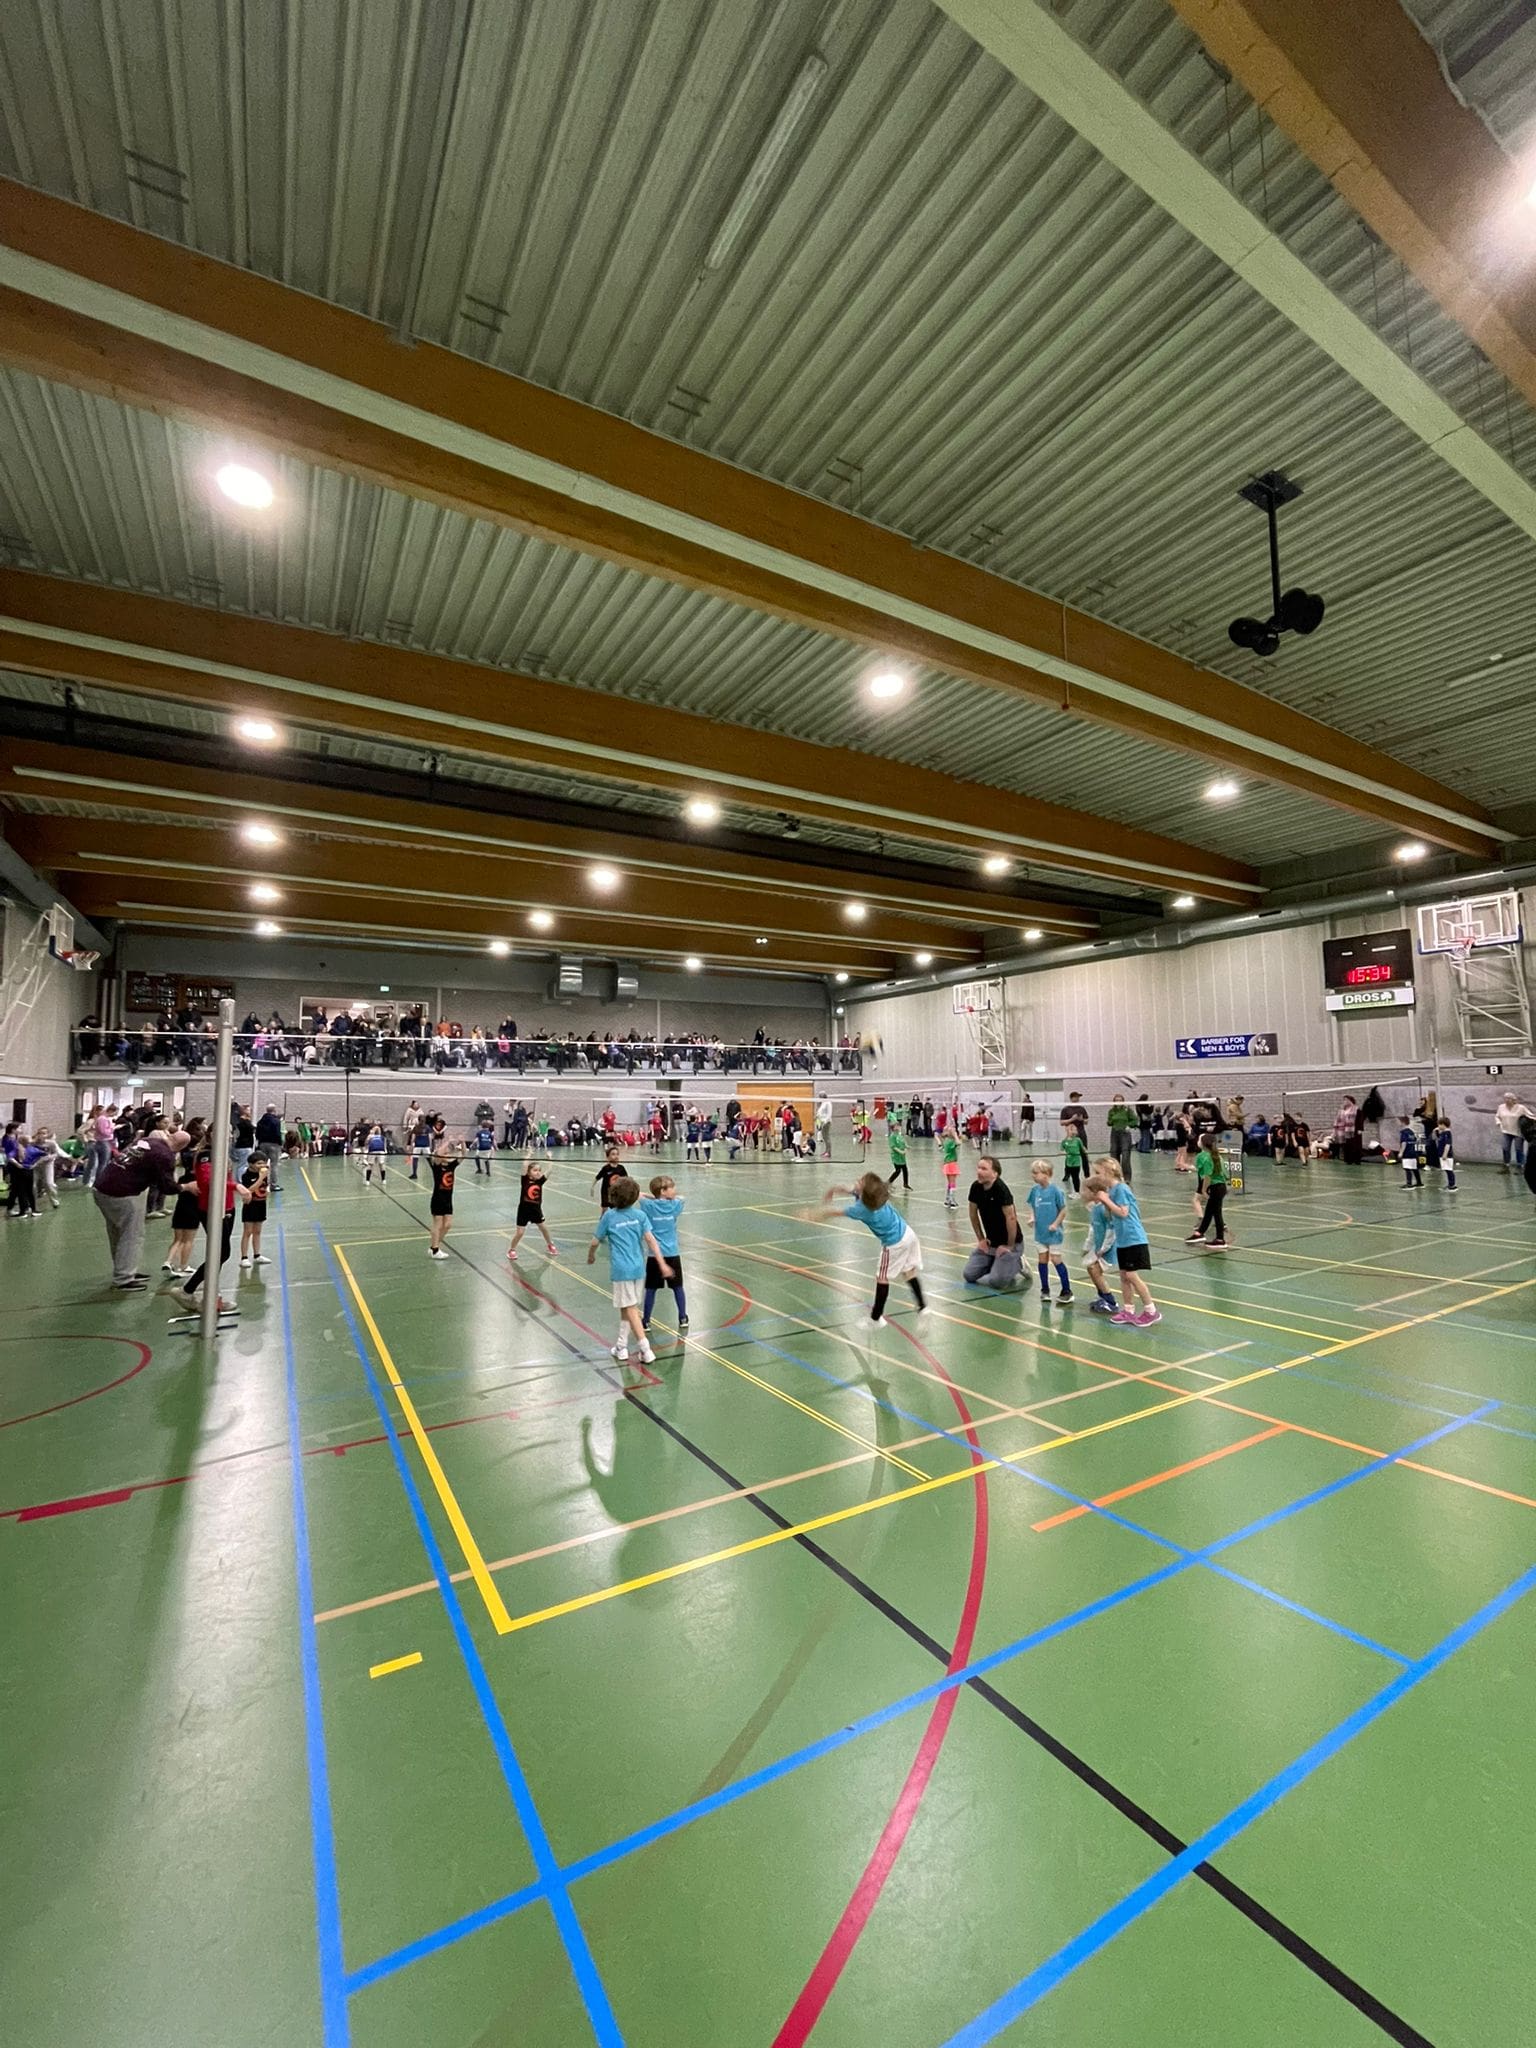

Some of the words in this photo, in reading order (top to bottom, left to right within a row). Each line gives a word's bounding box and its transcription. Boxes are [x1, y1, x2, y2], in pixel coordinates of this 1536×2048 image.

[1350, 966, 1391, 983] 15:34
[1345, 993, 1379, 1004] DROS
[1200, 1038, 1229, 1046] BARBER
[1201, 1045, 1217, 1053] MEN
